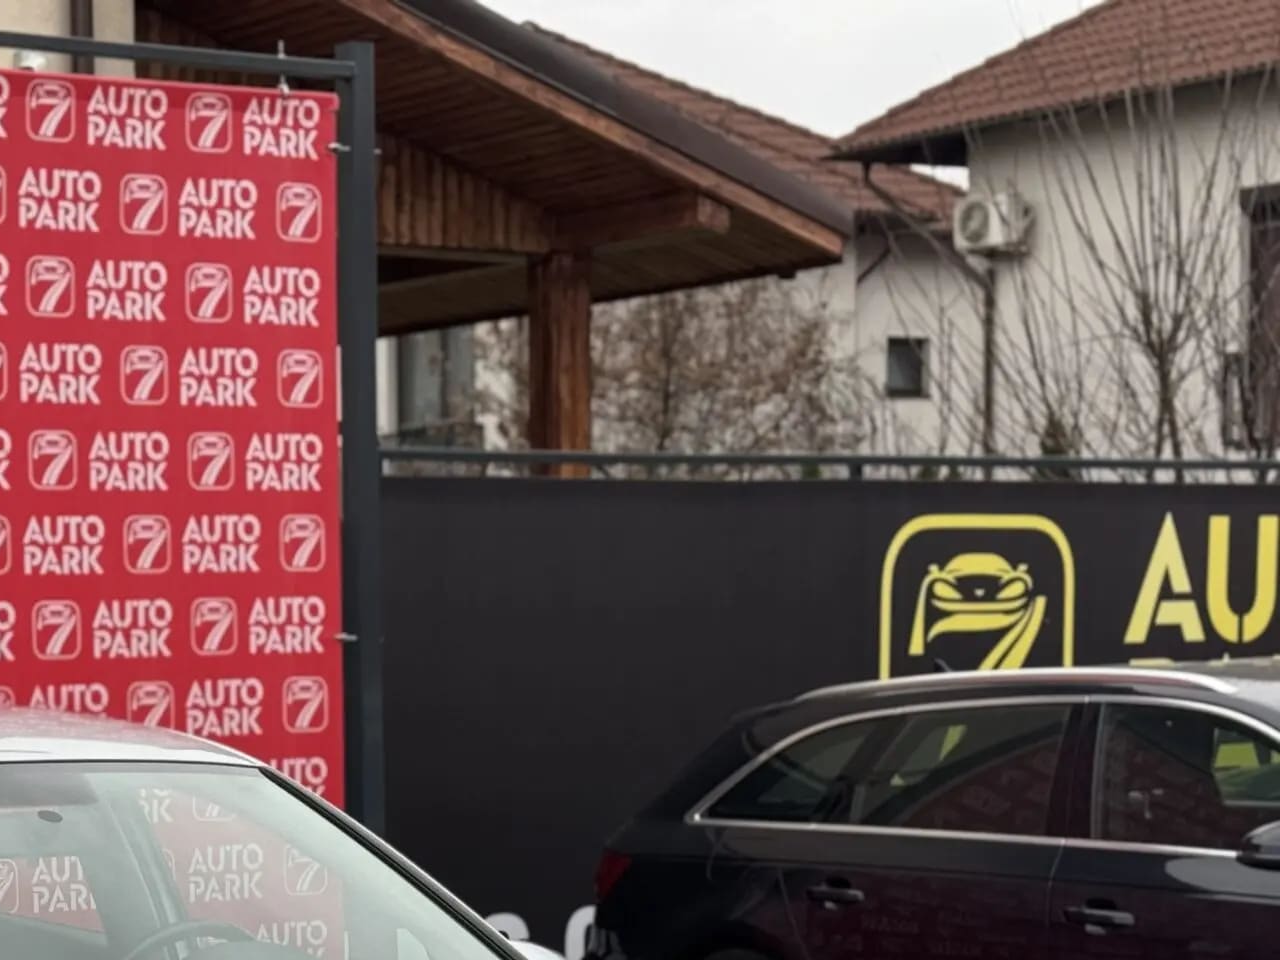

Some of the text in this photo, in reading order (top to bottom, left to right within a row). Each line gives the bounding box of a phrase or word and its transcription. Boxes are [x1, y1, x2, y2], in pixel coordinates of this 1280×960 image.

[88, 87, 168, 118] AUTO
[244, 98, 320, 128] AUTO
[87, 115, 166, 150] PARK
[244, 126, 318, 160] PARK
[19, 167, 102, 200] AUTO
[180, 178, 258, 209] AUTO
[19, 198, 99, 232] PARK
[181, 208, 256, 240] PARK
[88, 260, 168, 291] AUTO
[244, 266, 320, 297] AUTO
[87, 290, 166, 322] PARK
[245, 296, 319, 327] PARK
[20, 342, 102, 373] AUTO
[180, 347, 258, 377] AUTO
[20, 373, 100, 405] PARK
[180, 377, 257, 407] PARK
[90, 431, 170, 460] AUTO
[246, 433, 323, 461] AUTO
[89, 462, 168, 491] PARK
[247, 461, 321, 491] PARK
[24, 515, 105, 544] AUTO
[183, 514, 261, 542] AUTO
[24, 546, 104, 575] PARK
[184, 543, 260, 574] PARK
[93, 598, 173, 628] AUTO
[249, 596, 325, 626] AUTO
[94, 629, 172, 660] PARK
[251, 626, 325, 656] PARK
[30, 683, 109, 711] AUTO
[187, 677, 264, 706] AUTO
[189, 707, 262, 734] PARK
[188, 844, 264, 873] AUTO
[189, 871, 263, 901] PARK
